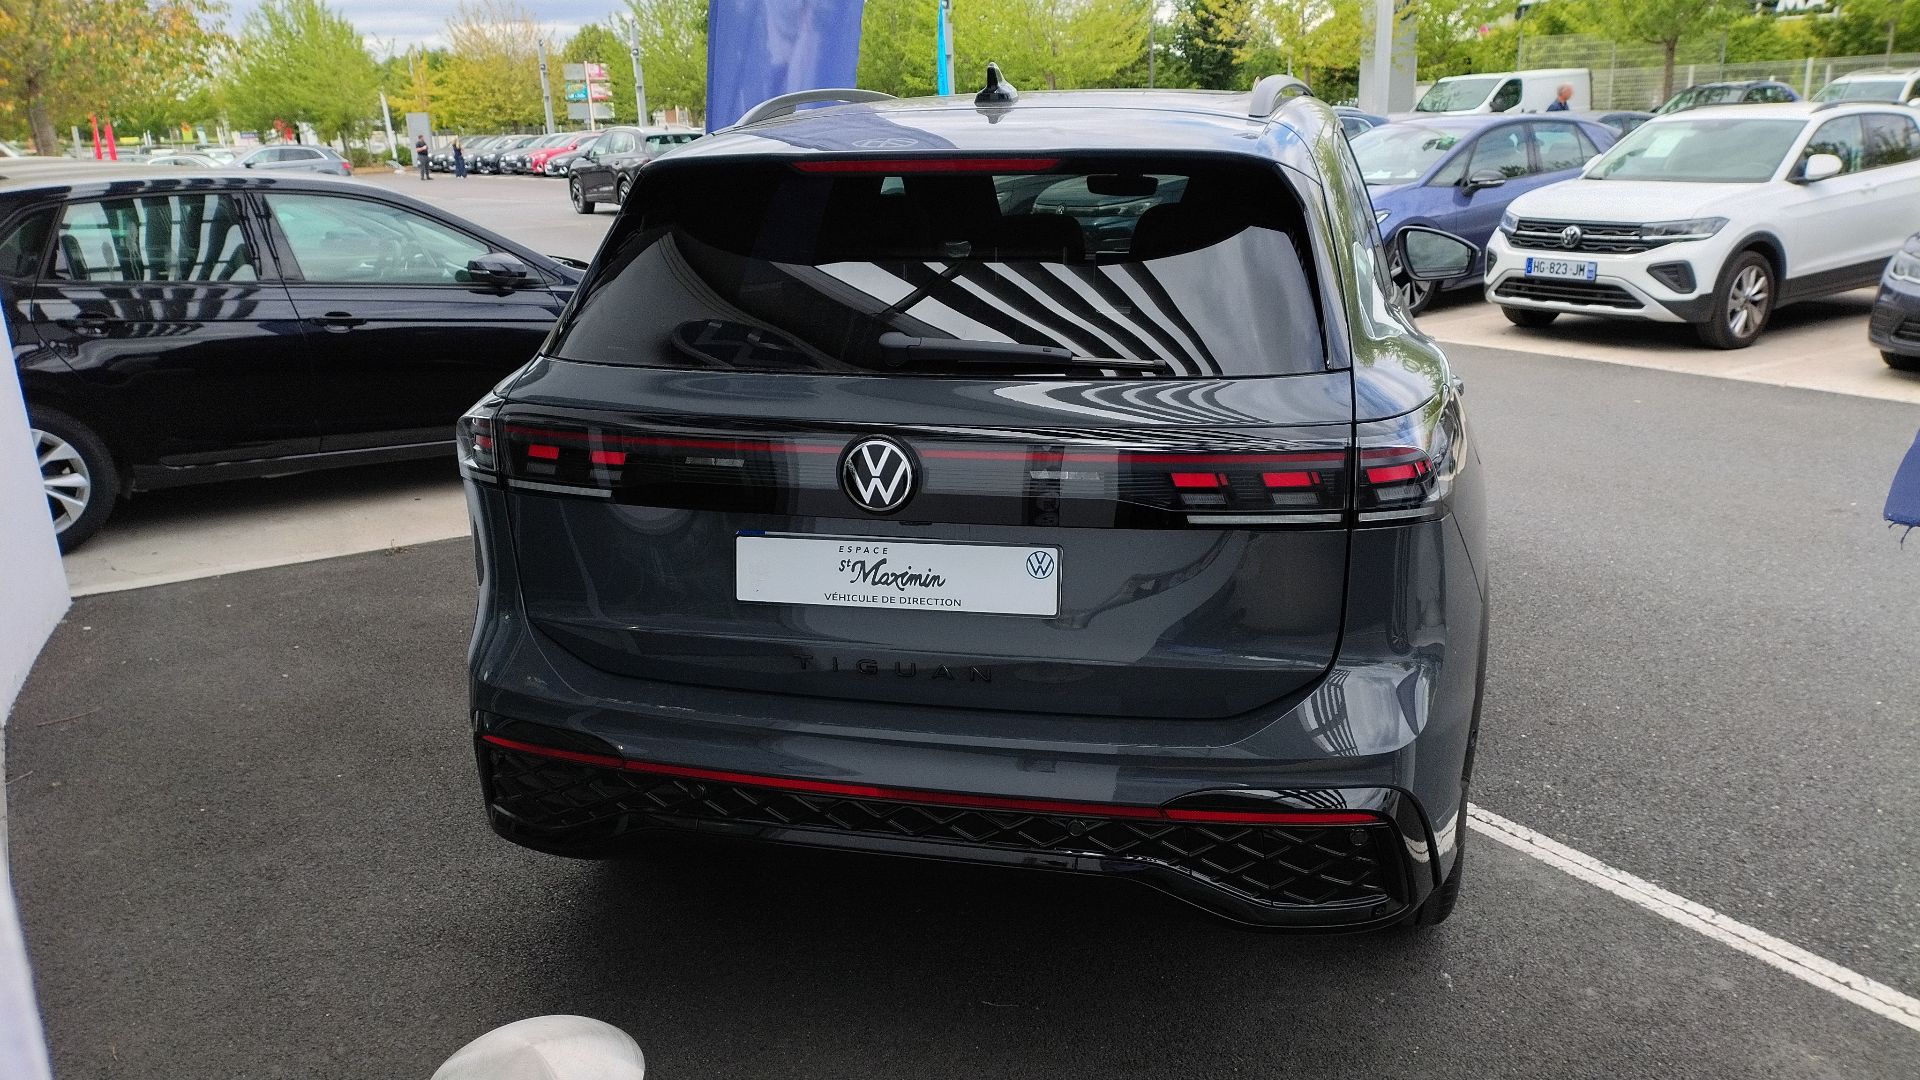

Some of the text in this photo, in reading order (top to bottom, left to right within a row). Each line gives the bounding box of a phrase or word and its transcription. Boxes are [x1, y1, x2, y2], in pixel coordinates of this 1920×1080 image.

[838, 545, 889, 555] ESPACE
[838, 557, 946, 591] St Maximin
[824, 592, 962, 607] VÉHICULE DE DIRECTION
[793, 654, 993, 683] TIGUAN
